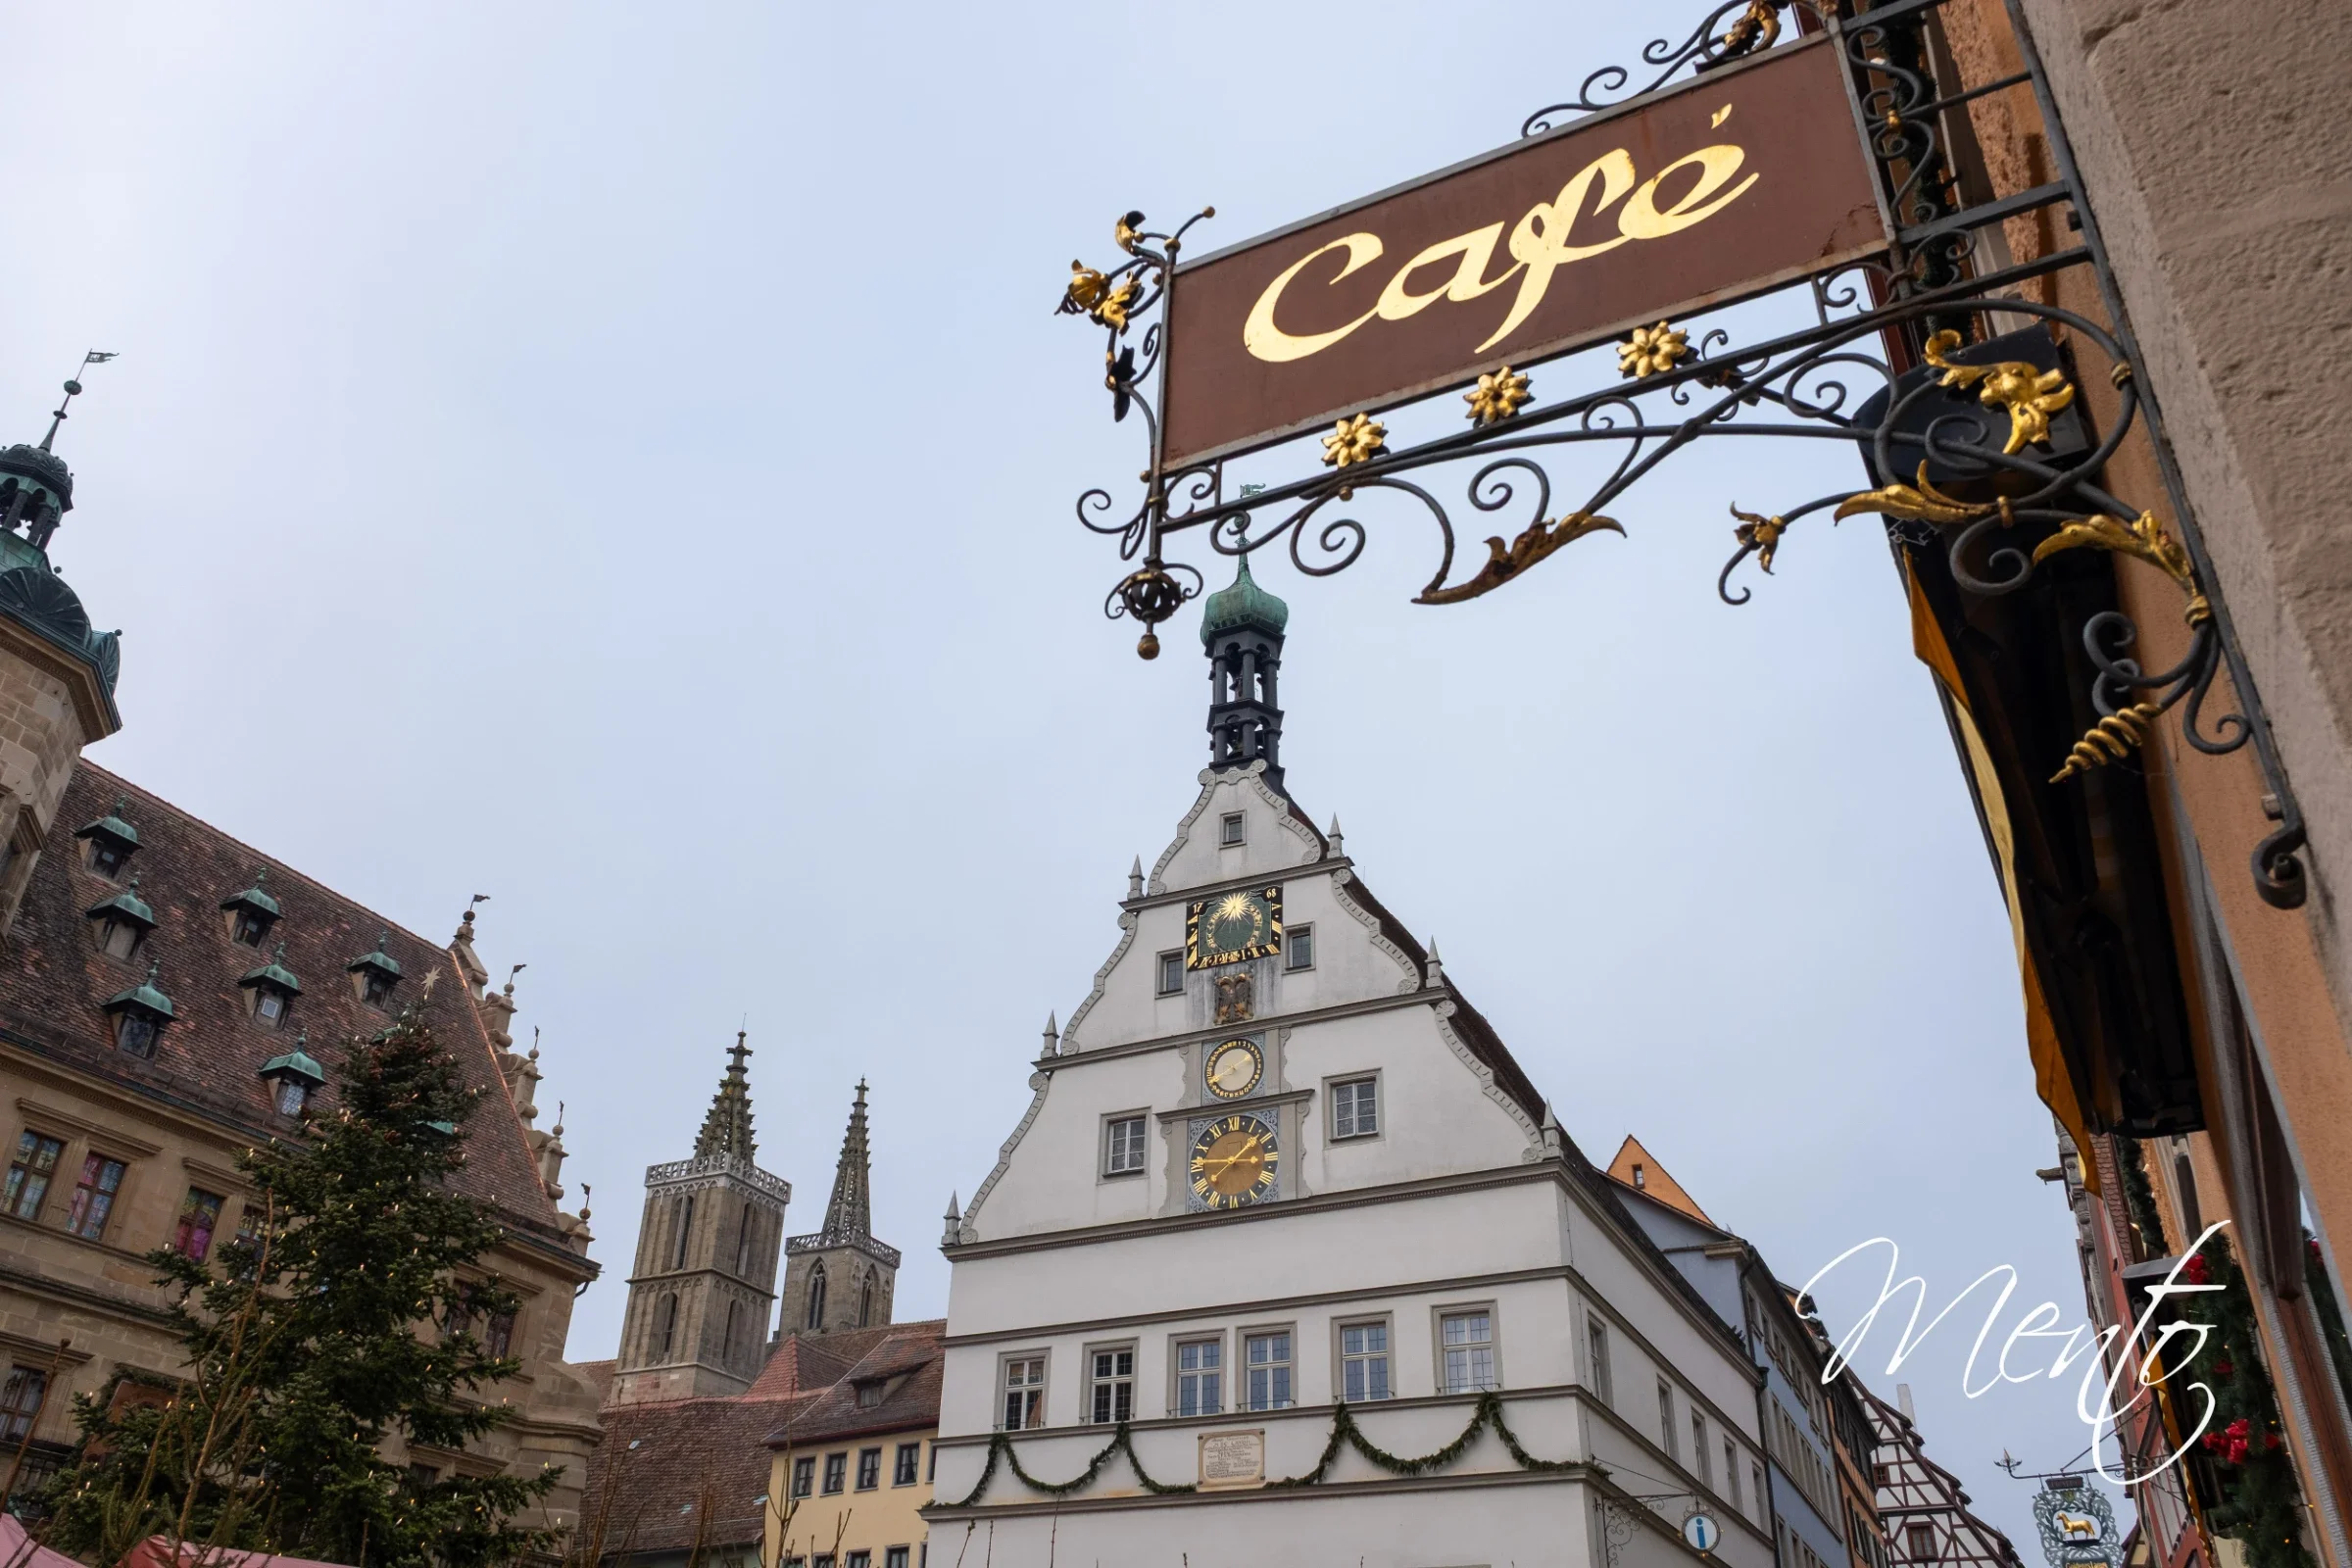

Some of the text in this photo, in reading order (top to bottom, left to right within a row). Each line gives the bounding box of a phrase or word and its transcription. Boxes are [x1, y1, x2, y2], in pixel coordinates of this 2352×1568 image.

[1243, 103, 1759, 363] Café
[1266, 888, 1277, 899] 68
[1193, 902, 1203, 913] 17
[1228, 1116, 1240, 1131] XII
[1249, 1119, 1256, 1133] I
[1208, 1123, 1222, 1139] XI
[1259, 1132, 1273, 1144] II
[1196, 1142, 1209, 1152] X
[1264, 1152, 1279, 1161] III
[1206, 1191, 1221, 1207] VII
[1249, 1188, 1258, 1200] V
[1229, 1196, 1239, 1208] VI
[1695, 1518, 1706, 1548] i
